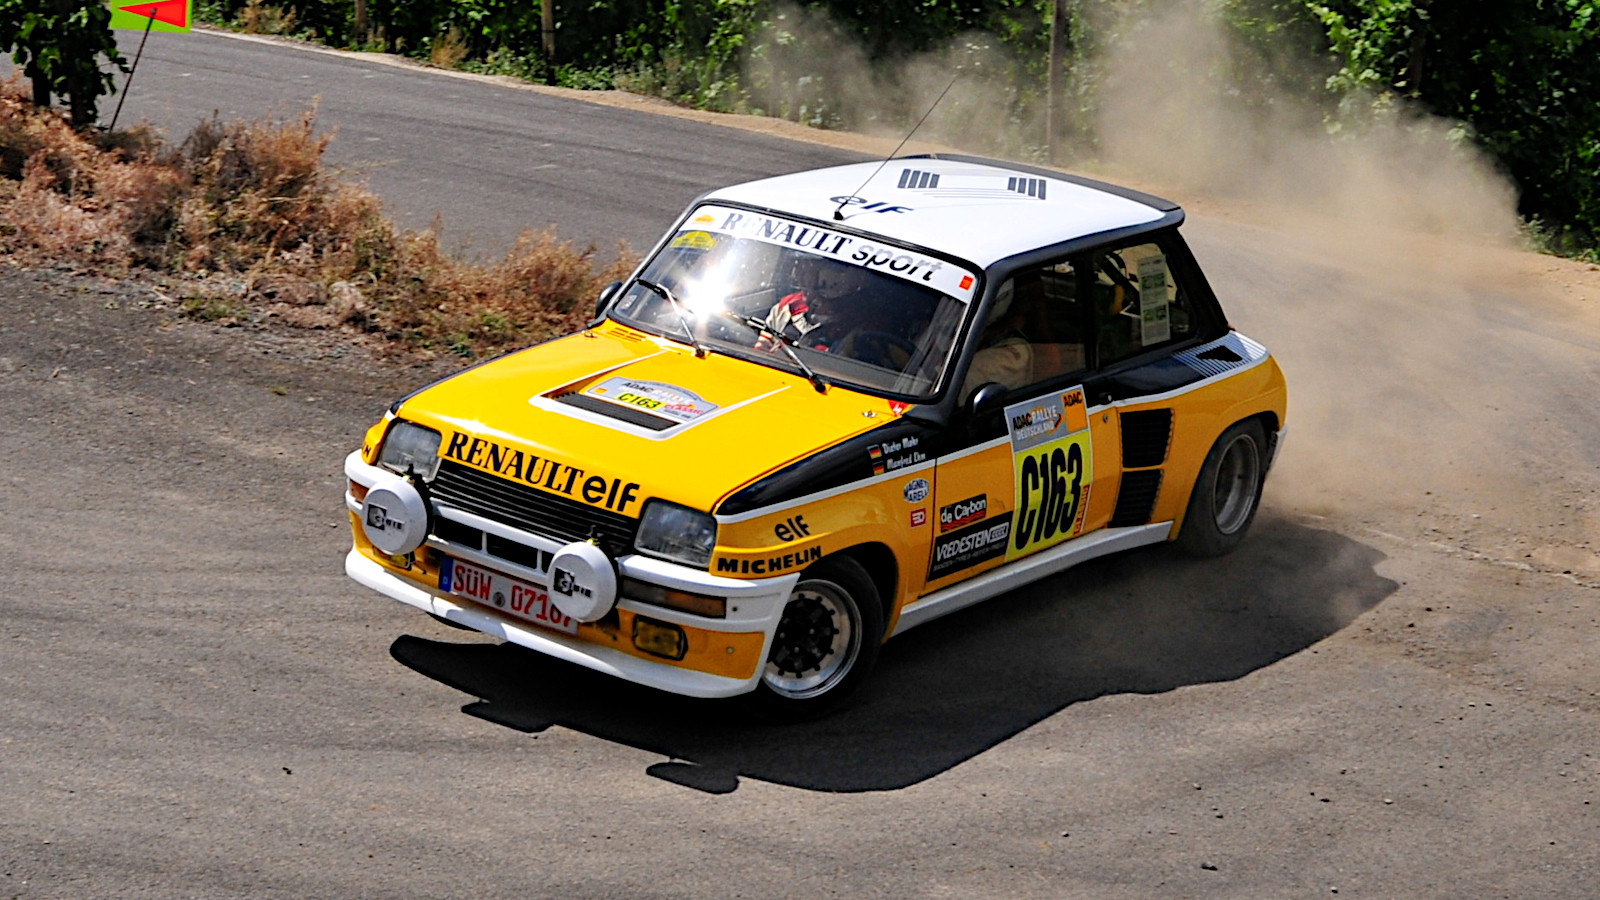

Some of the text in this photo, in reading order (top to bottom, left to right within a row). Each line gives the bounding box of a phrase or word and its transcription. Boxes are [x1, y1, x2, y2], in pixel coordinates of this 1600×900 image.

[829, 195, 914, 214] elf
[851, 244, 943, 281] sport
[618, 392, 661, 409] C163
[622, 382, 654, 393] ADAC
[1063, 391, 1083, 407] ADAC
[1013, 405, 1058, 431] ADAC RALLYE
[445, 430, 640, 513] RENAULT elf
[1015, 442, 1082, 550] C163
[941, 499, 986, 523] de Carbon
[774, 514, 811, 542] elf
[717, 545, 822, 574] MICHELIN
[937, 529, 991, 562] VREDESTEIN
[453, 564, 492, 601] SÜW
